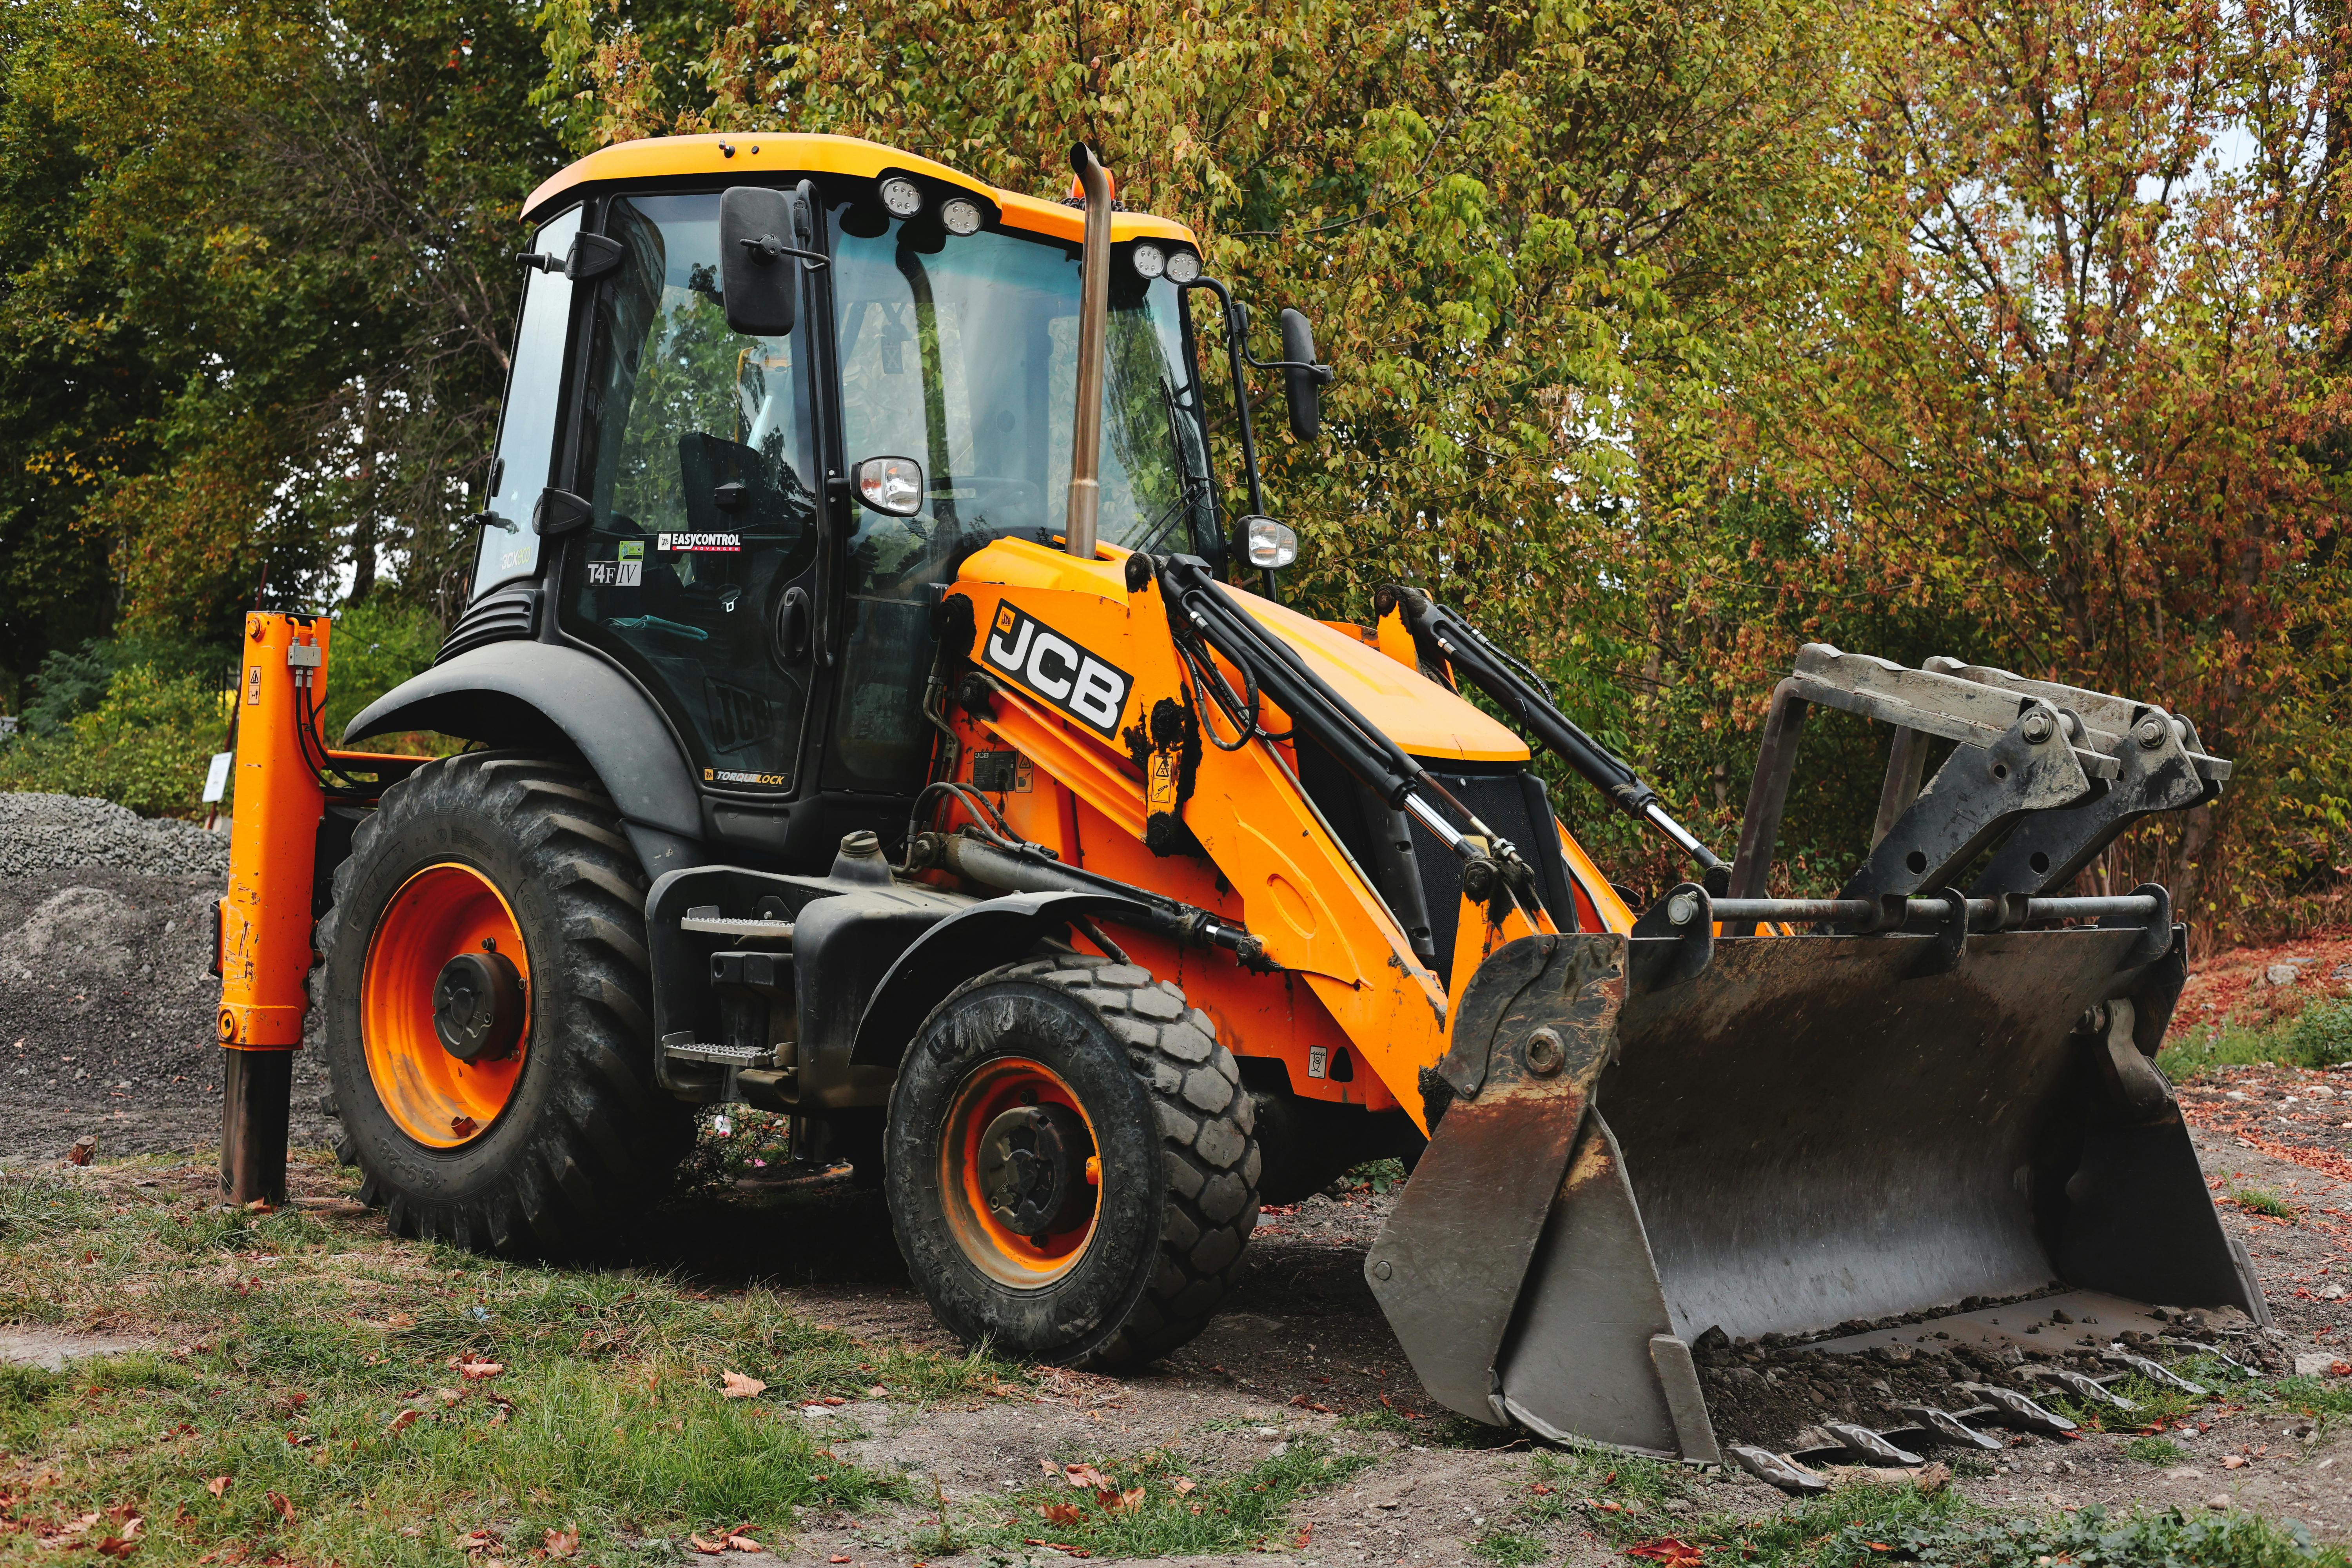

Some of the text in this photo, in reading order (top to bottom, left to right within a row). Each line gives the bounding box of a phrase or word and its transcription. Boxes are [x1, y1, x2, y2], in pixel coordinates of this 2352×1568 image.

[672, 534, 740, 547] EASYCONTROL
[1002, 613, 1011, 625] JCB
[989, 619, 1124, 729] JCB
[715, 771, 785, 785] TORQUELOCK
[533, 931, 552, 1049] SEHA
[379, 1138, 441, 1189] 16.9-28
